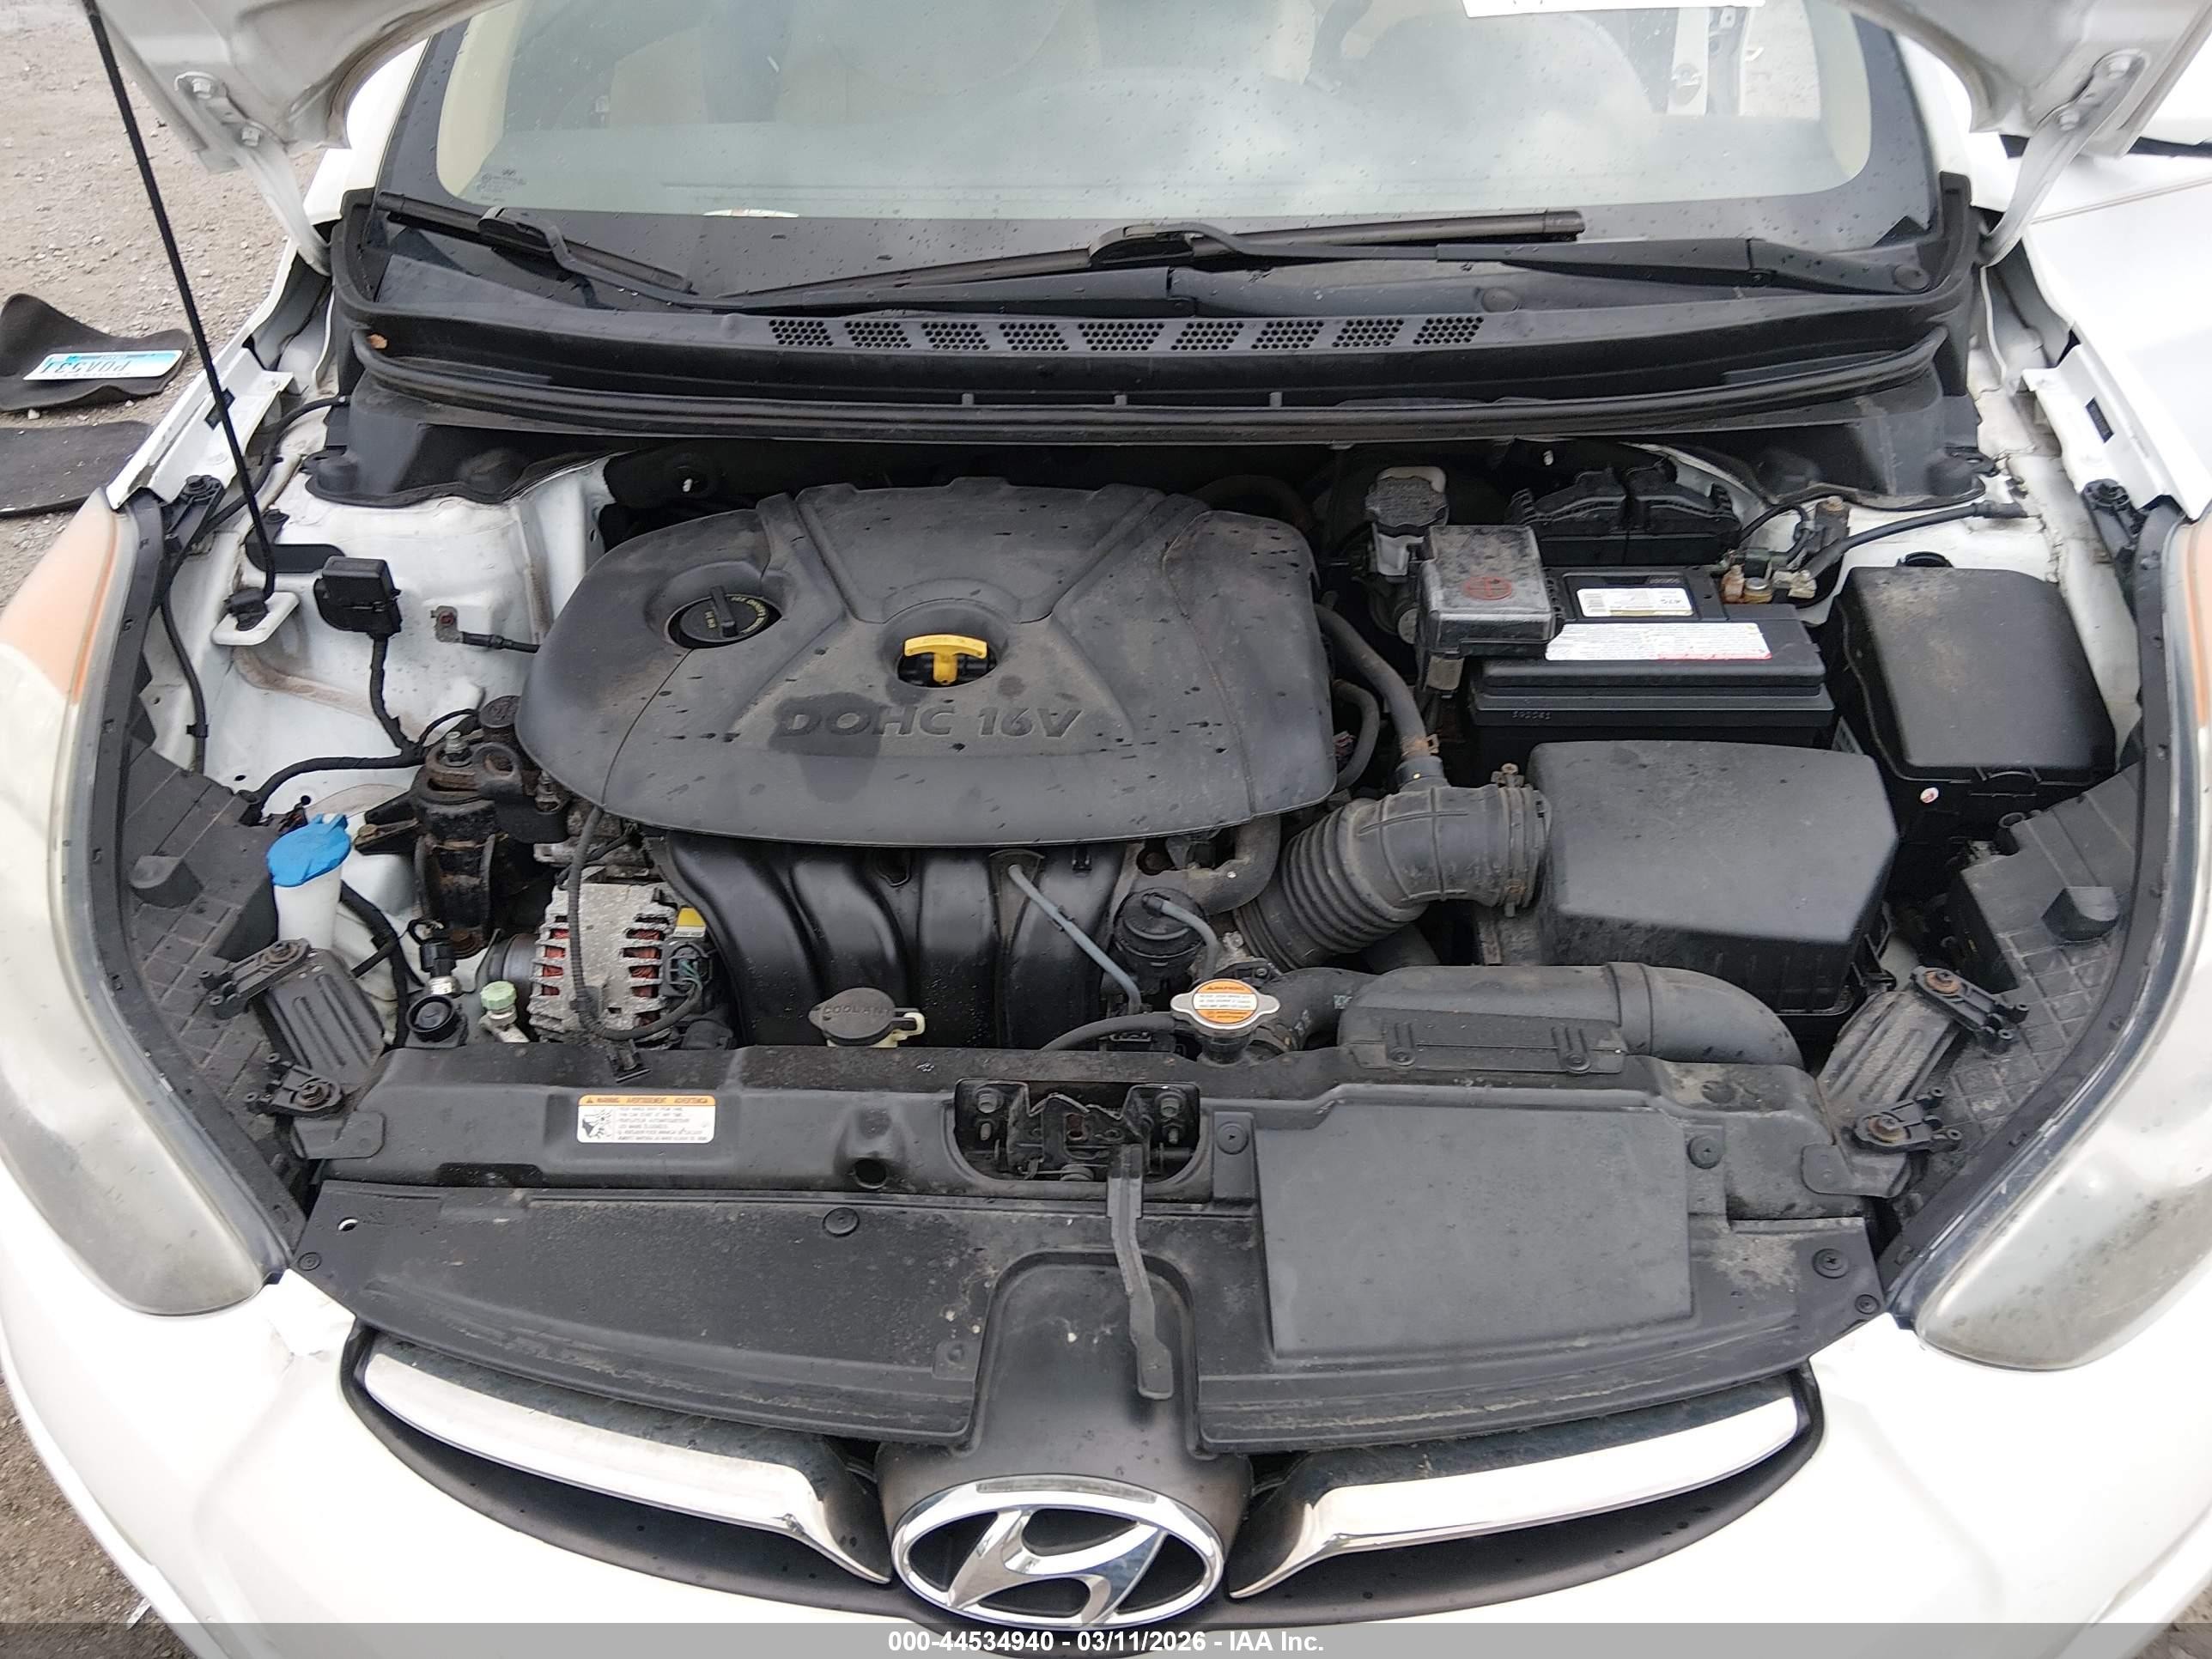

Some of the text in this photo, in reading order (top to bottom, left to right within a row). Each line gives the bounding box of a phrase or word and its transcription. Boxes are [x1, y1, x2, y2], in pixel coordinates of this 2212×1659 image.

[775, 705, 1083, 738] DOHC 16V
[823, 1005, 891, 1018] COOLANT
